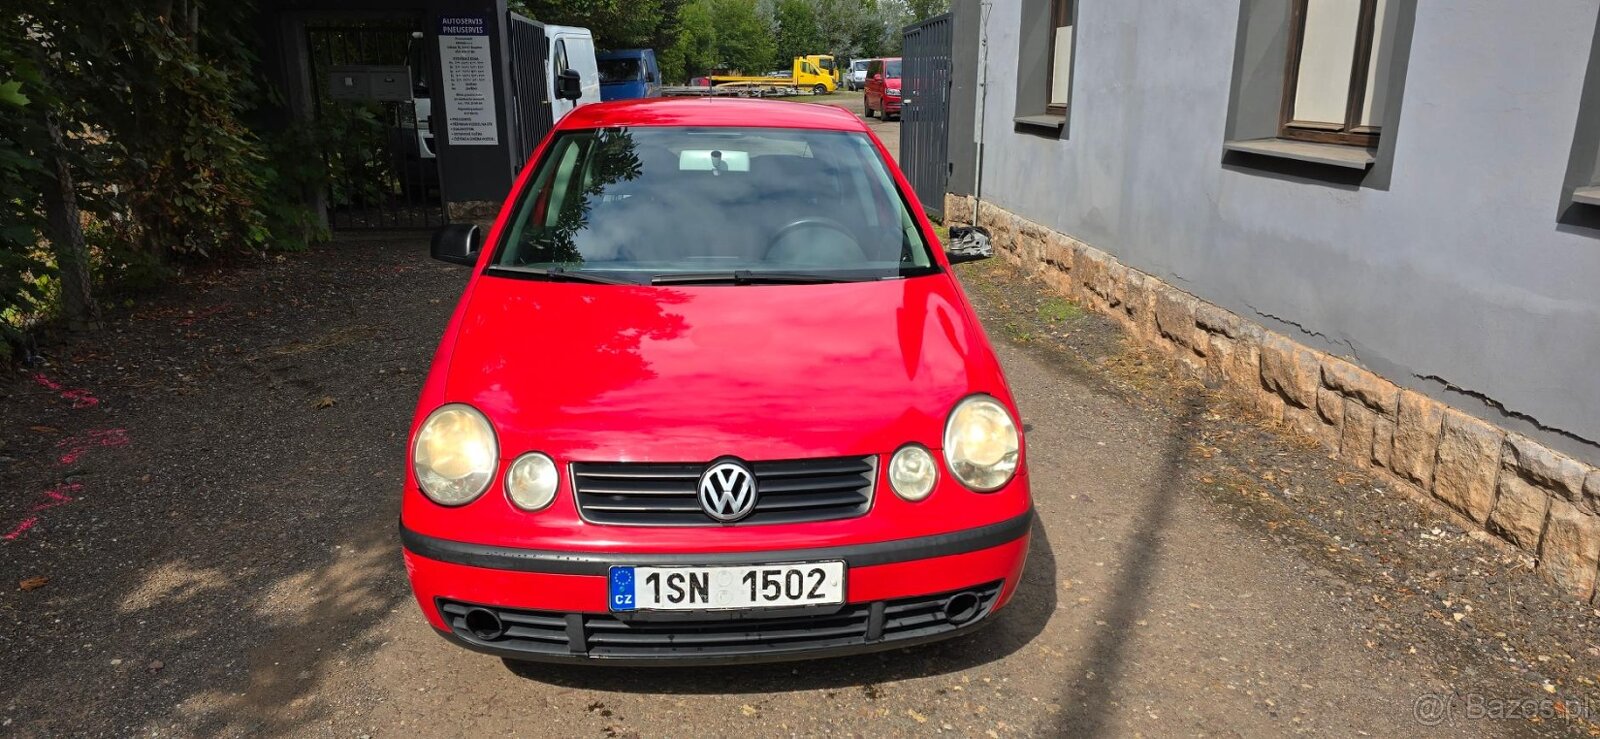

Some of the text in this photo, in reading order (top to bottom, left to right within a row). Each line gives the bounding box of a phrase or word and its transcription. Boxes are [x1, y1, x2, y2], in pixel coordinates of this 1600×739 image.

[442, 17, 484, 25] AUTOSERVIS
[442, 26, 484, 34] PNEUSERVIS
[701, 464, 755, 519] VW
[645, 567, 827, 604] 1SN 1502
[614, 593, 633, 605] CZ
